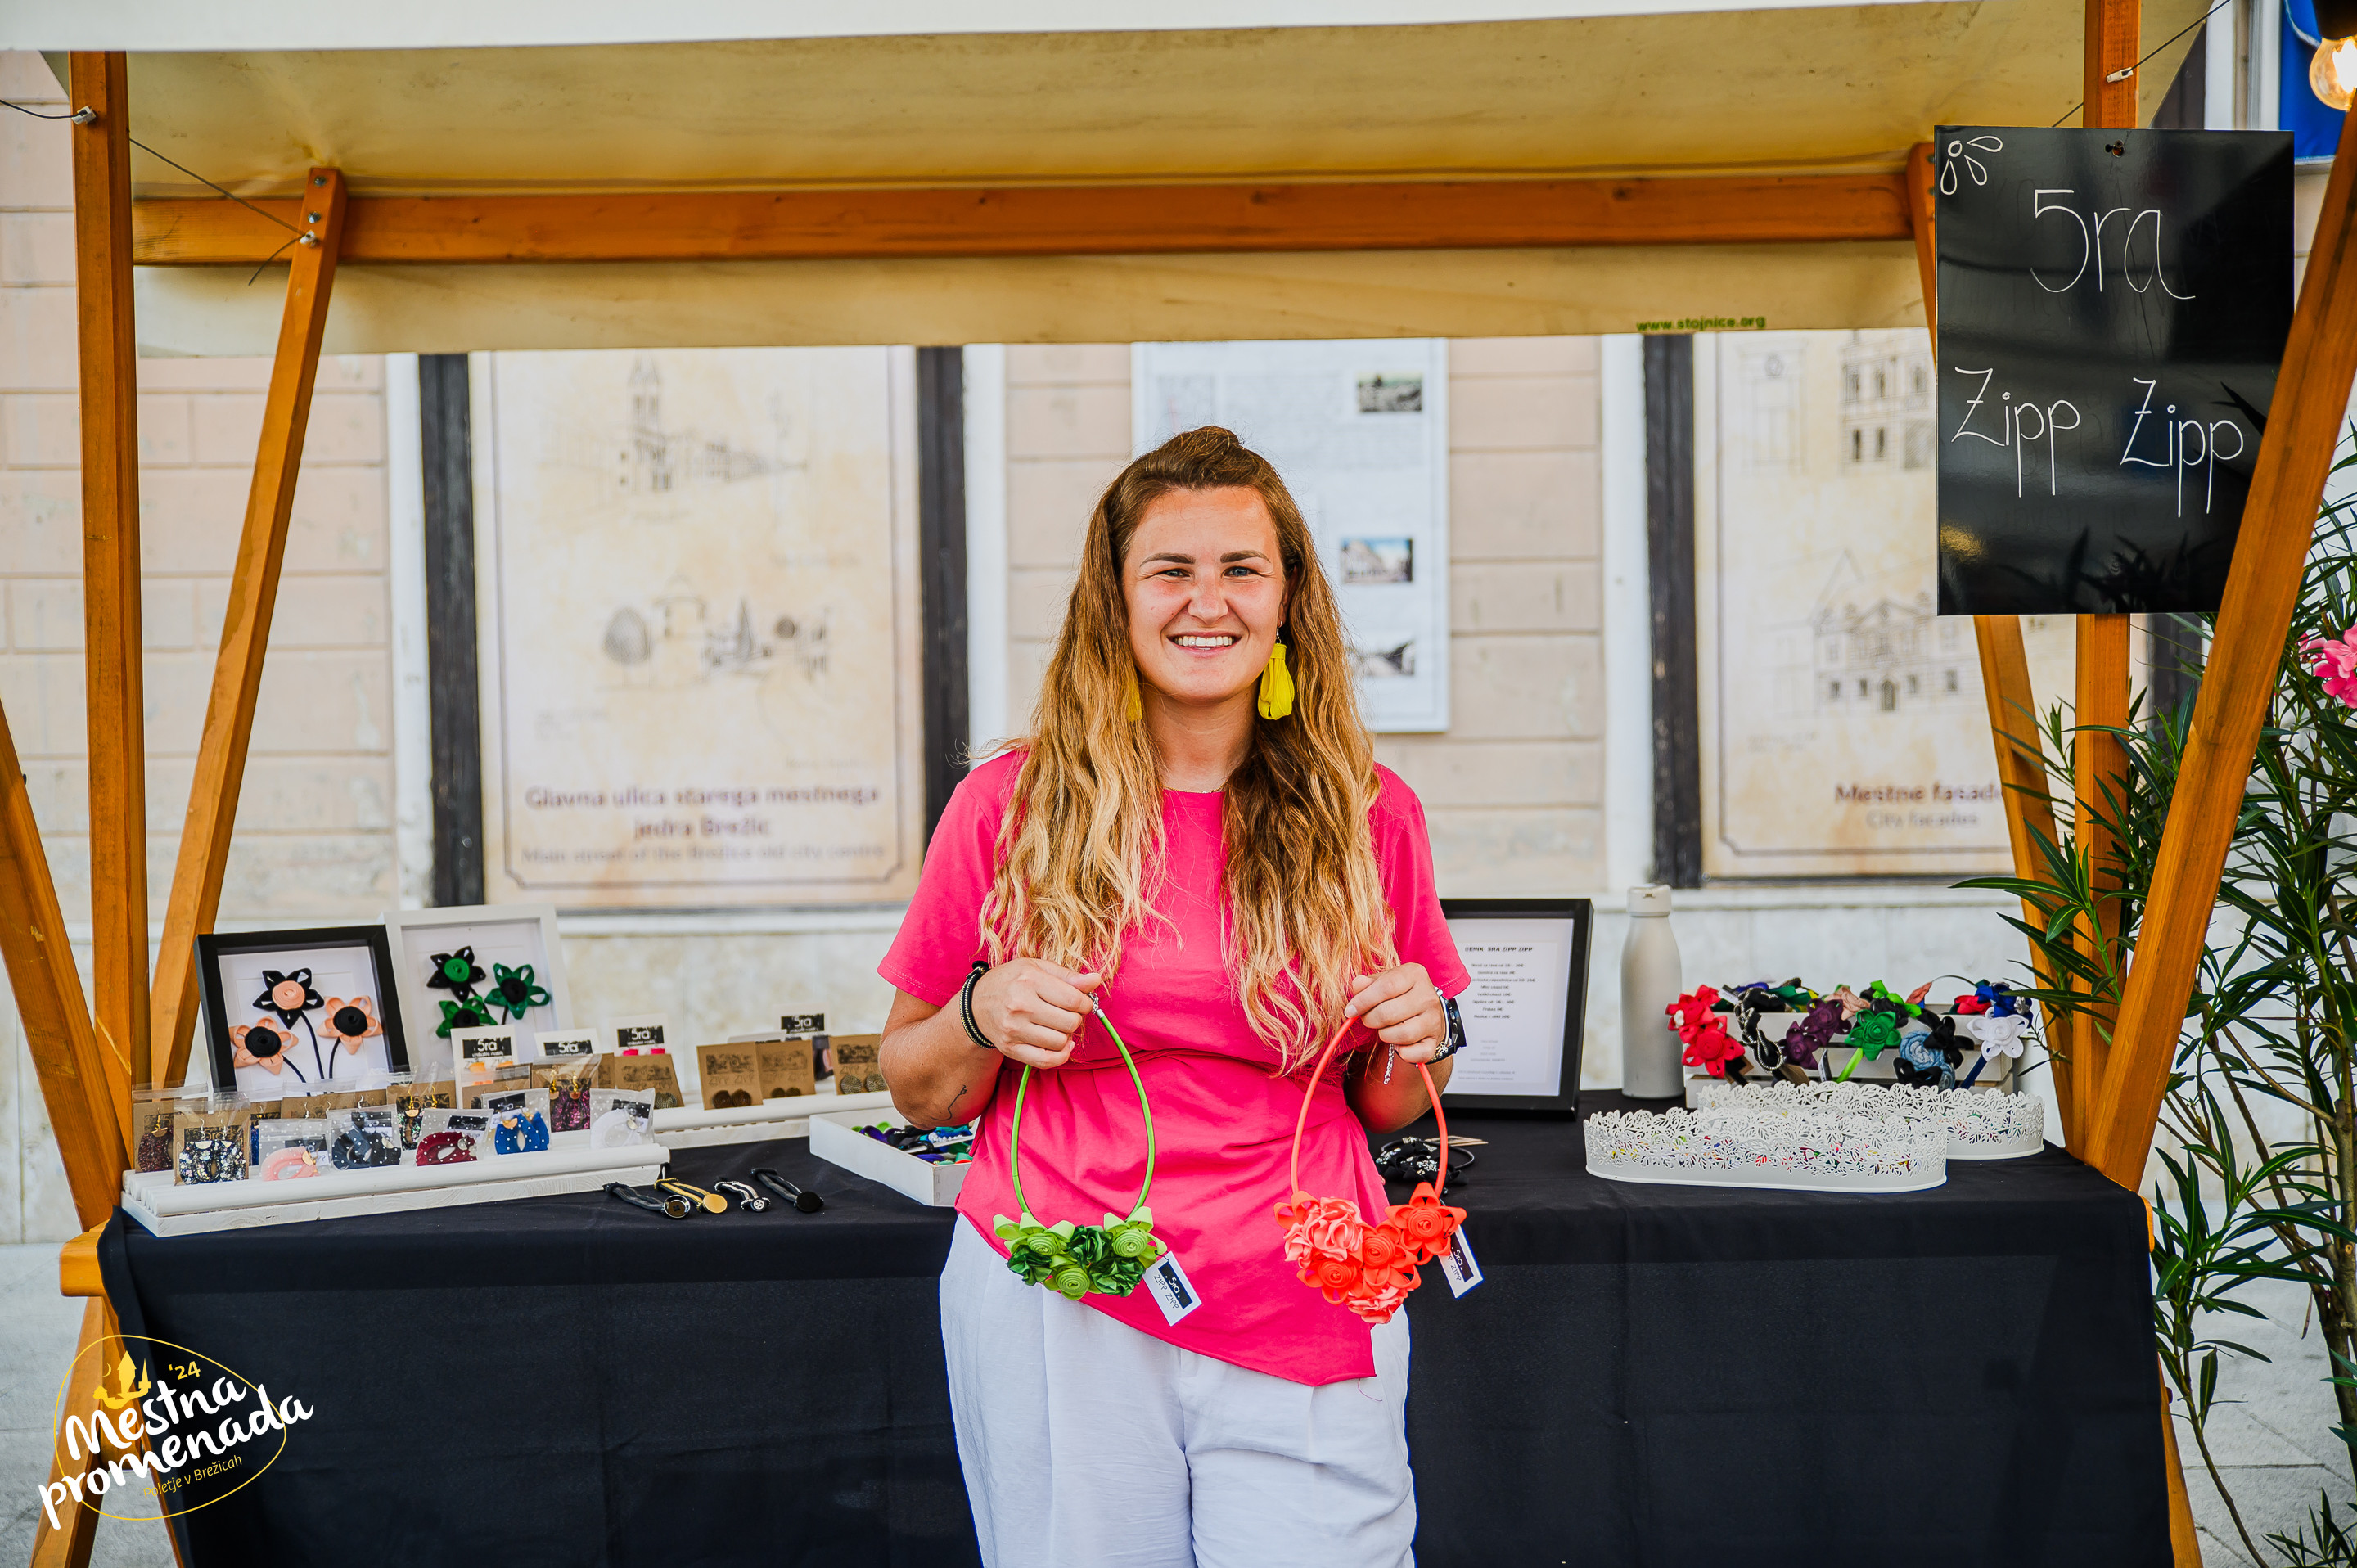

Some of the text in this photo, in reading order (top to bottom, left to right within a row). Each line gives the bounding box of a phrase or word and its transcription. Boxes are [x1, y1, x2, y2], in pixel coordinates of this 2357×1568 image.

[2030, 189, 2196, 299] 5ra
[1636, 315, 1766, 331] www.stojnice.org
[1951, 367, 2244, 517] Zipp Zipp
[525, 786, 877, 808] Glavna ulica starega mestnega
[1835, 783, 1925, 801] Mestne
[633, 818, 692, 842] jedra
[631, 1028, 651, 1040] 5ra
[477, 1039, 498, 1052] 5ra
[1453, 1249, 1463, 1266] 5ra
[1450, 1264, 1462, 1281] ZIPP
[1153, 1274, 1179, 1309] ZIPP ZIPP
[1168, 1277, 1181, 1294] 5ra
